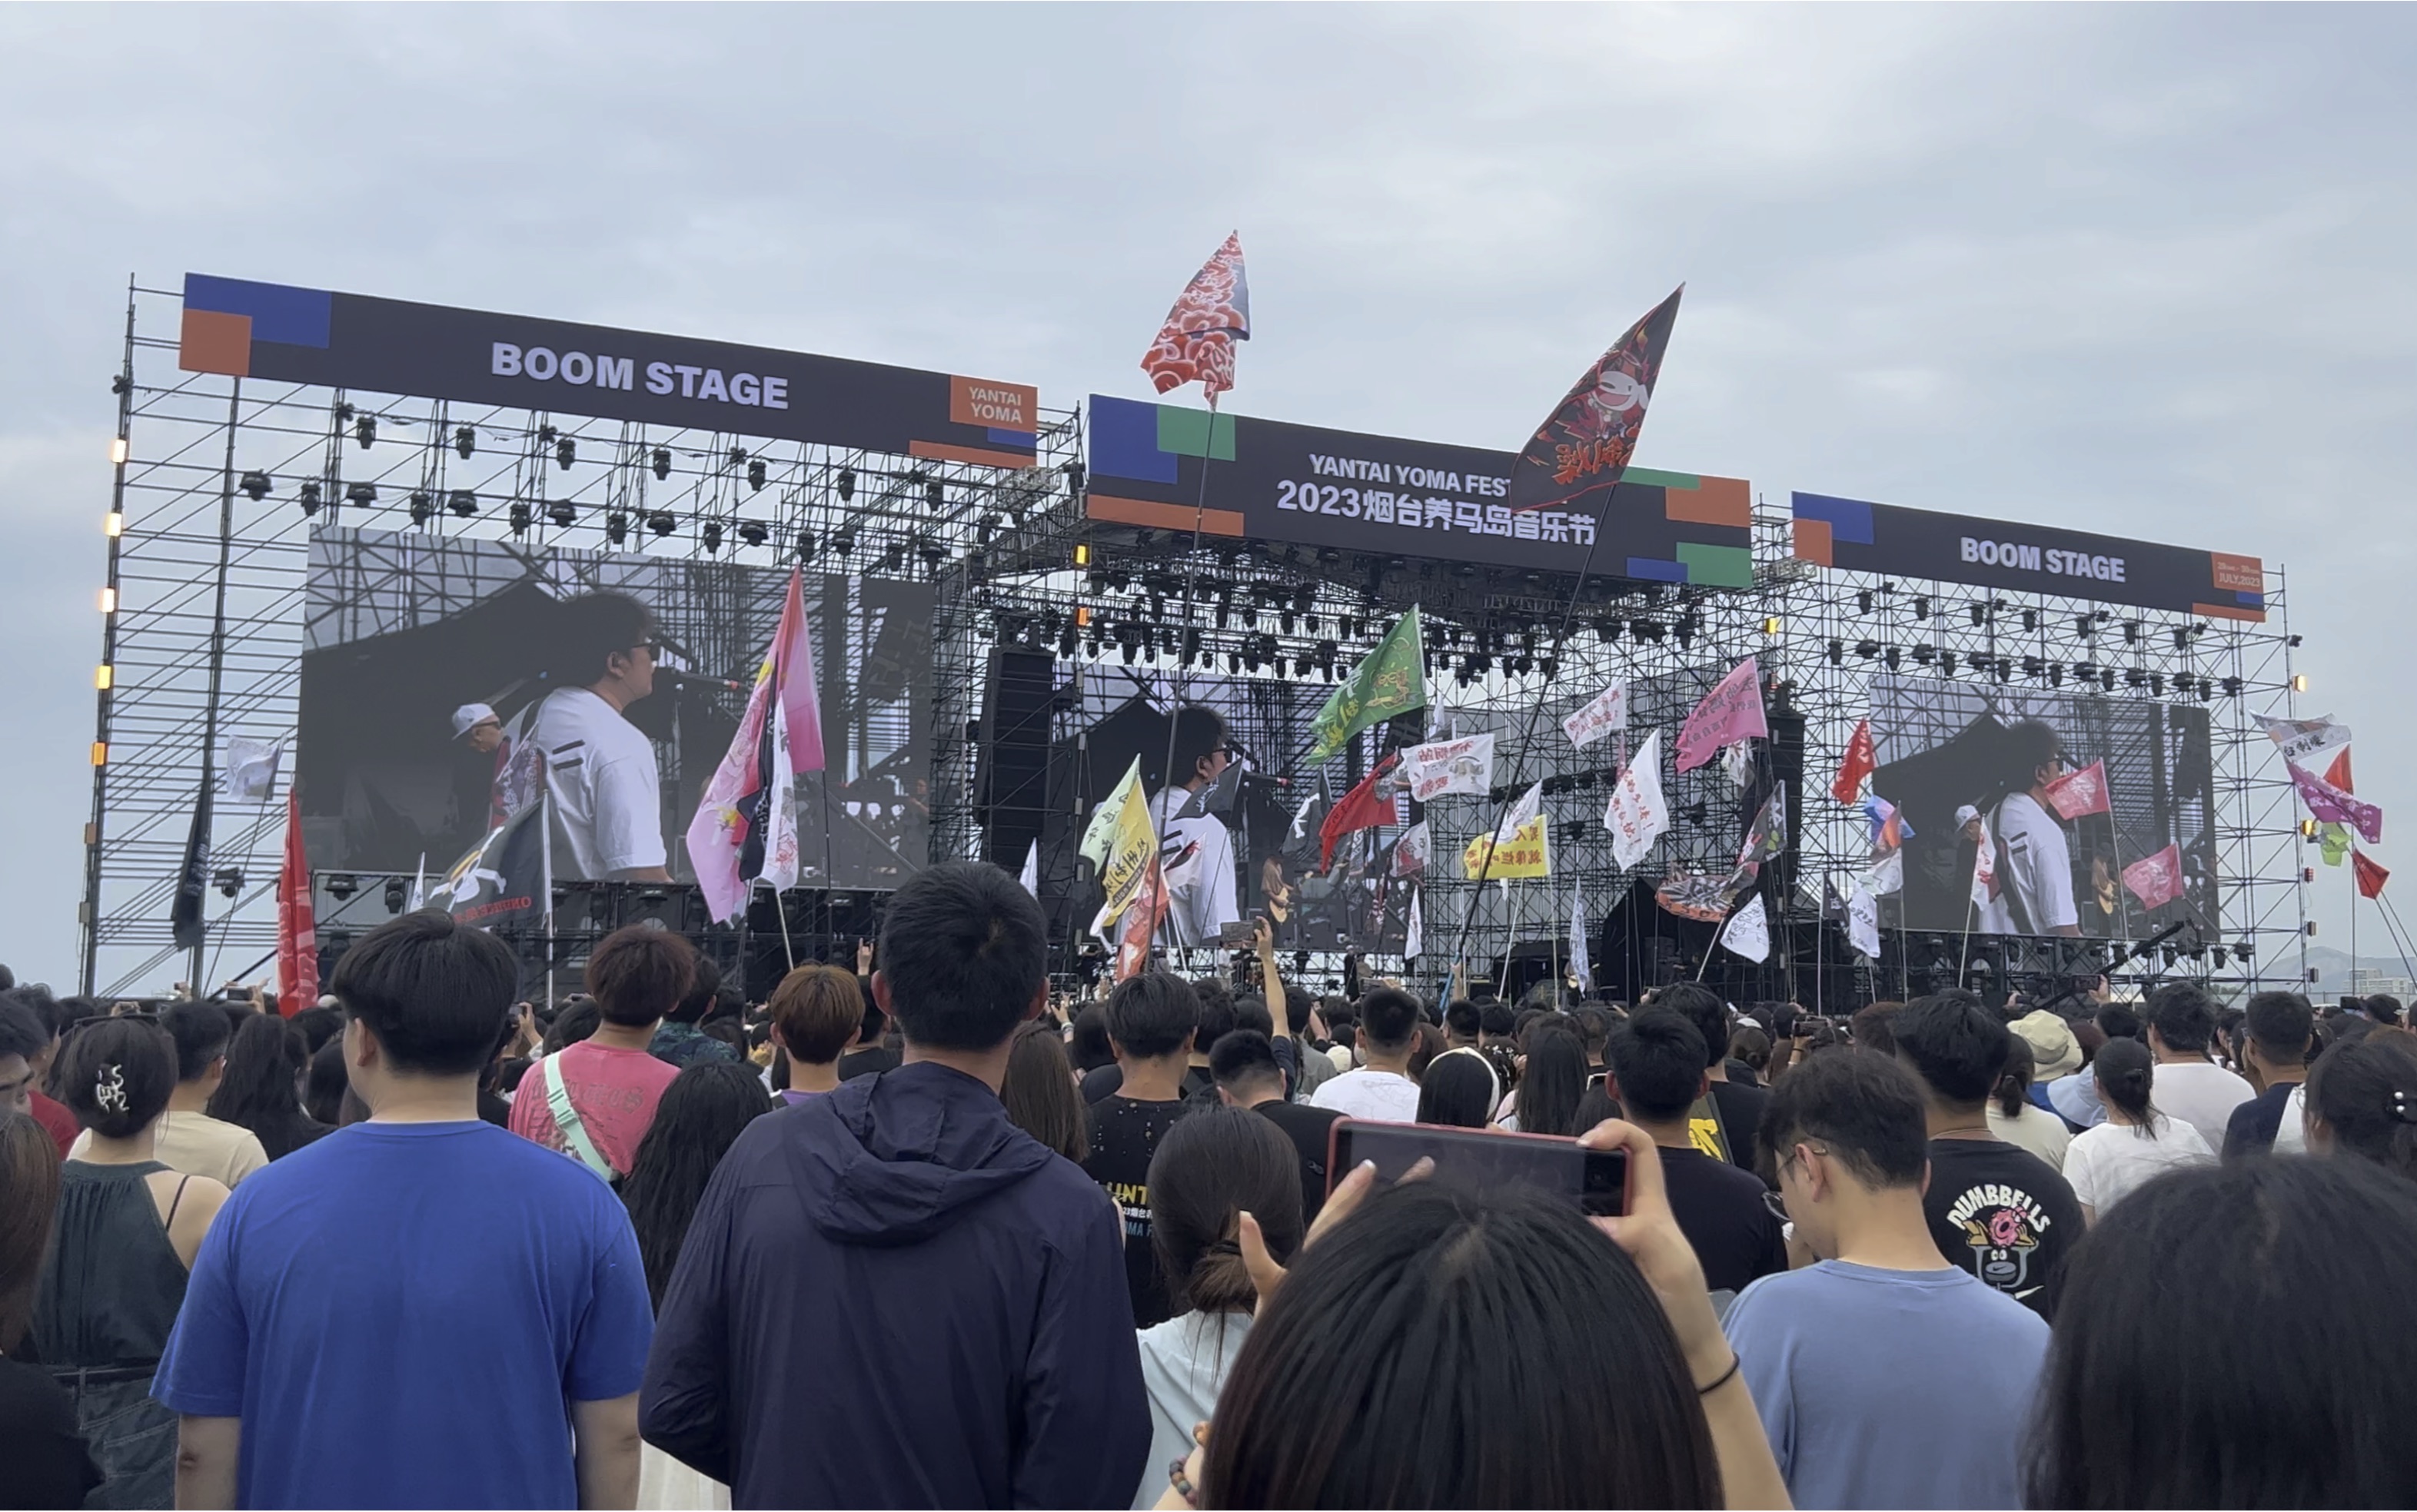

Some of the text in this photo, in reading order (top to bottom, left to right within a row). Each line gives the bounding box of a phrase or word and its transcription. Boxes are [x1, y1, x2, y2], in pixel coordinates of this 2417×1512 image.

[491, 341, 789, 410] BOOM STAGE
[969, 386, 1022, 406] YANTAI
[971, 402, 1022, 424] YOMA
[1309, 453, 1511, 498] YANTAI YOMA FES
[1276, 480, 1595, 546] 2023烟台养马岛音乐节
[1961, 537, 2126, 583] BOOM STAGE
[1947, 1185, 2051, 1233] DUMBBELLS
